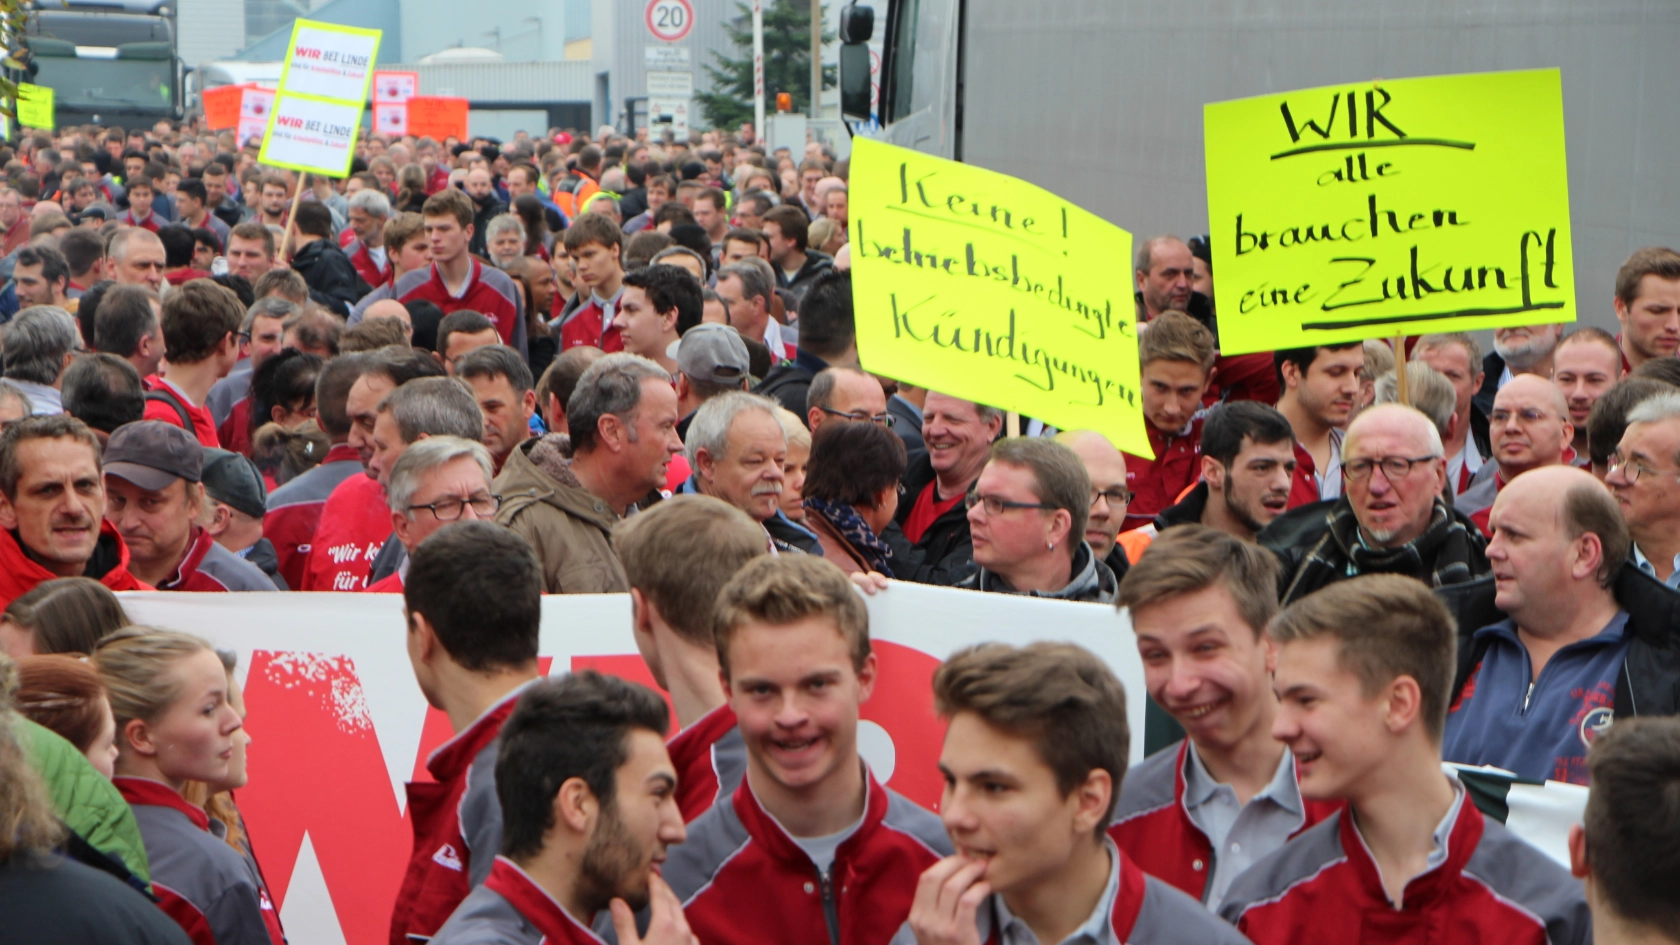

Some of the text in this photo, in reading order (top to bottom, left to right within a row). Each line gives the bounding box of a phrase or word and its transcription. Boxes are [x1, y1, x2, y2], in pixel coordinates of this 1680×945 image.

[657, 6, 684, 27] 20
[295, 45, 369, 67] WIR BEI LINDE
[277, 115, 352, 137] WIR BEI LINDE
[1280, 87, 1408, 143] WIR
[1317, 152, 1402, 187] alle
[1235, 193, 1472, 257] brauchen
[857, 219, 1134, 340] betriebsbedingte
[1239, 227, 1561, 315] eine Zukunft
[890, 293, 1138, 409] Kündigungen
[333, 571, 360, 591] für
